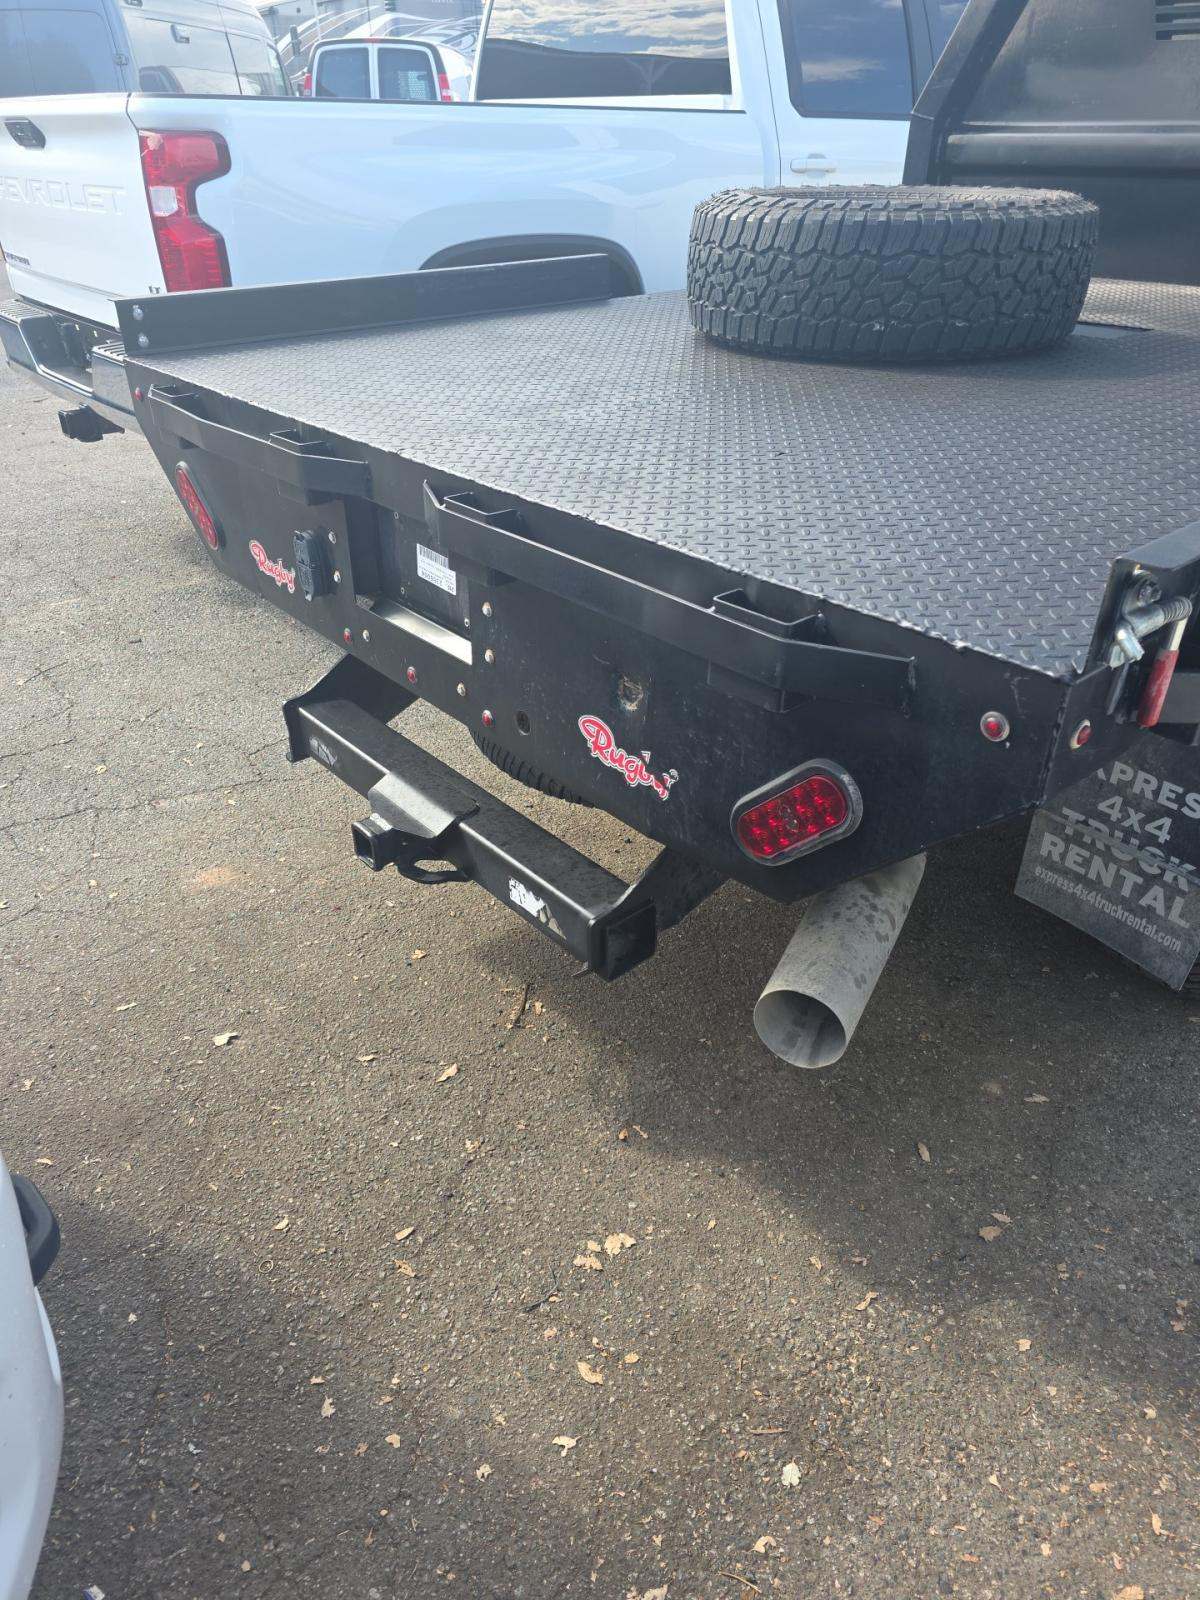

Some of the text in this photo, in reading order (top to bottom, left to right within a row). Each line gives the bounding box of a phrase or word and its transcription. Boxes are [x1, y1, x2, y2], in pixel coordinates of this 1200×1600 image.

[249, 540, 295, 594] Rugby
[1040, 833, 1190, 928] RENTAL
[1061, 807, 1197, 892] TRUCK
[1034, 866, 1182, 952] express4x4truckrental.com
